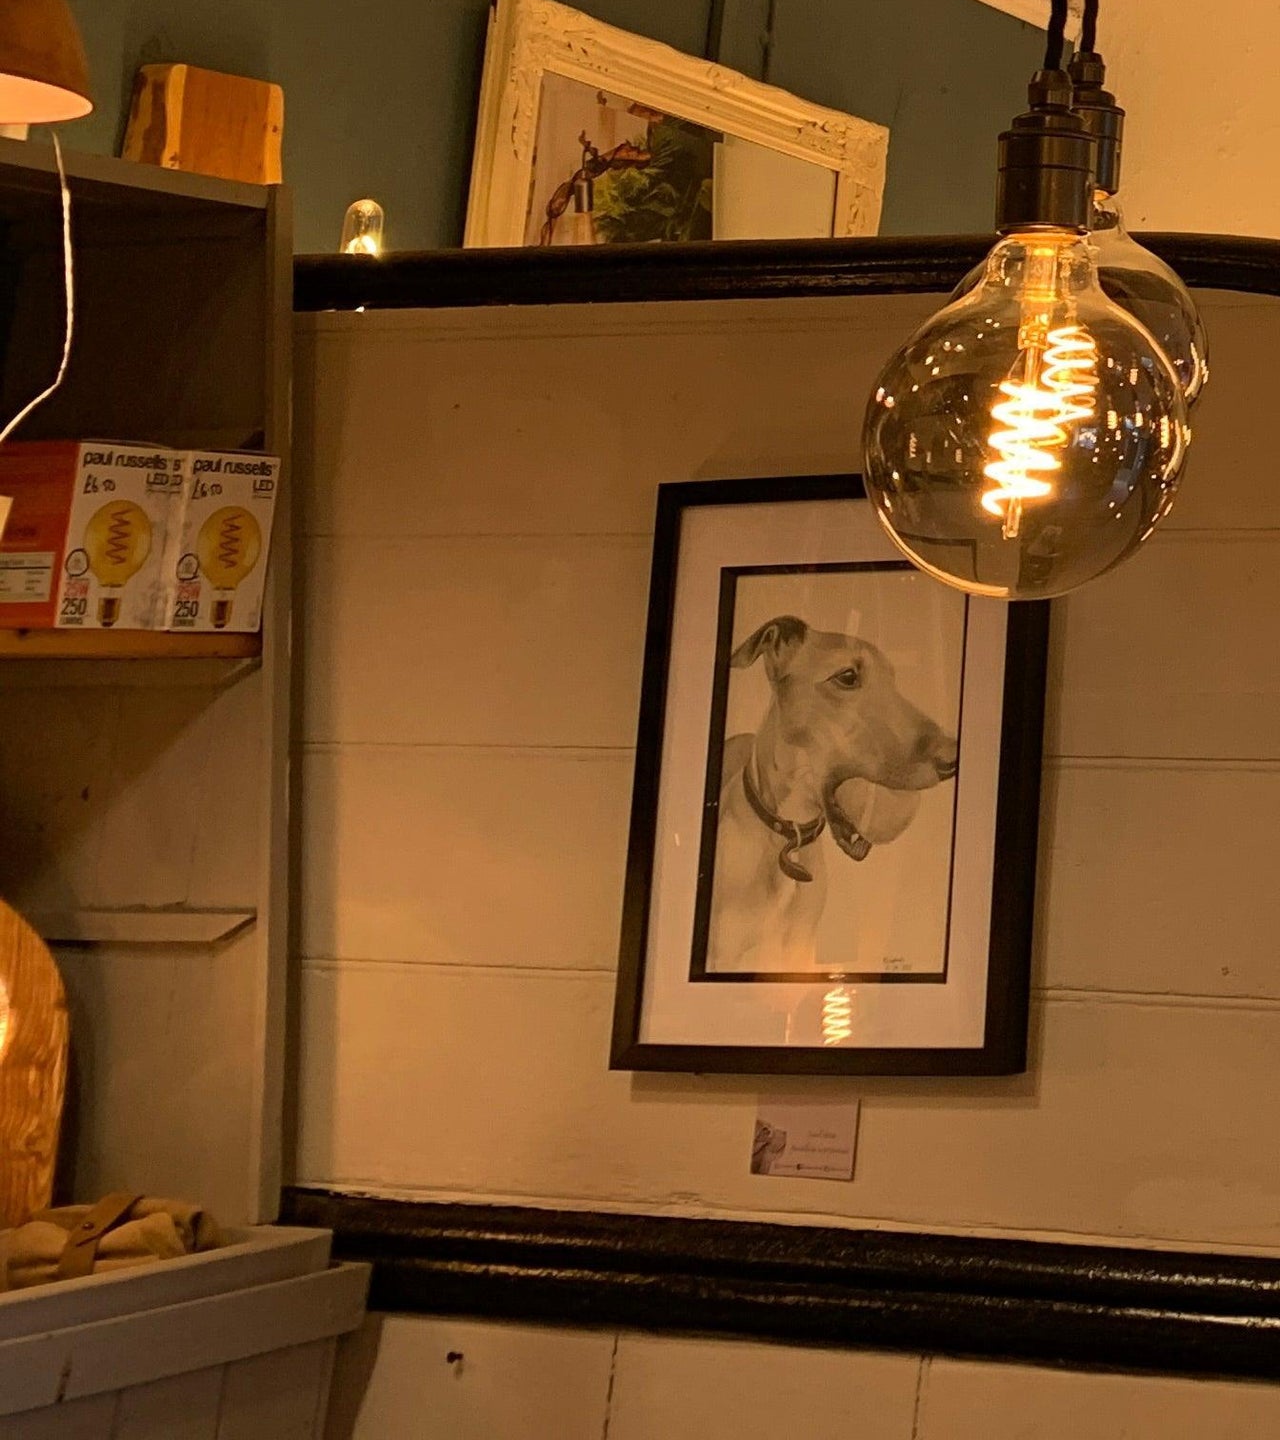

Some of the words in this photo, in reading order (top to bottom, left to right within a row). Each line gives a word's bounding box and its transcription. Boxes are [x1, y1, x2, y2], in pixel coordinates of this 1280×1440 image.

[83, 451, 113, 467] paul
[115, 454, 168, 470] russells
[193, 459, 222, 474] paul
[224, 462, 273, 476] russells
[146, 473, 169, 486] LED
[253, 479, 274, 492] LED
[61, 598, 87, 615] 250
[175, 601, 199, 618] 250
